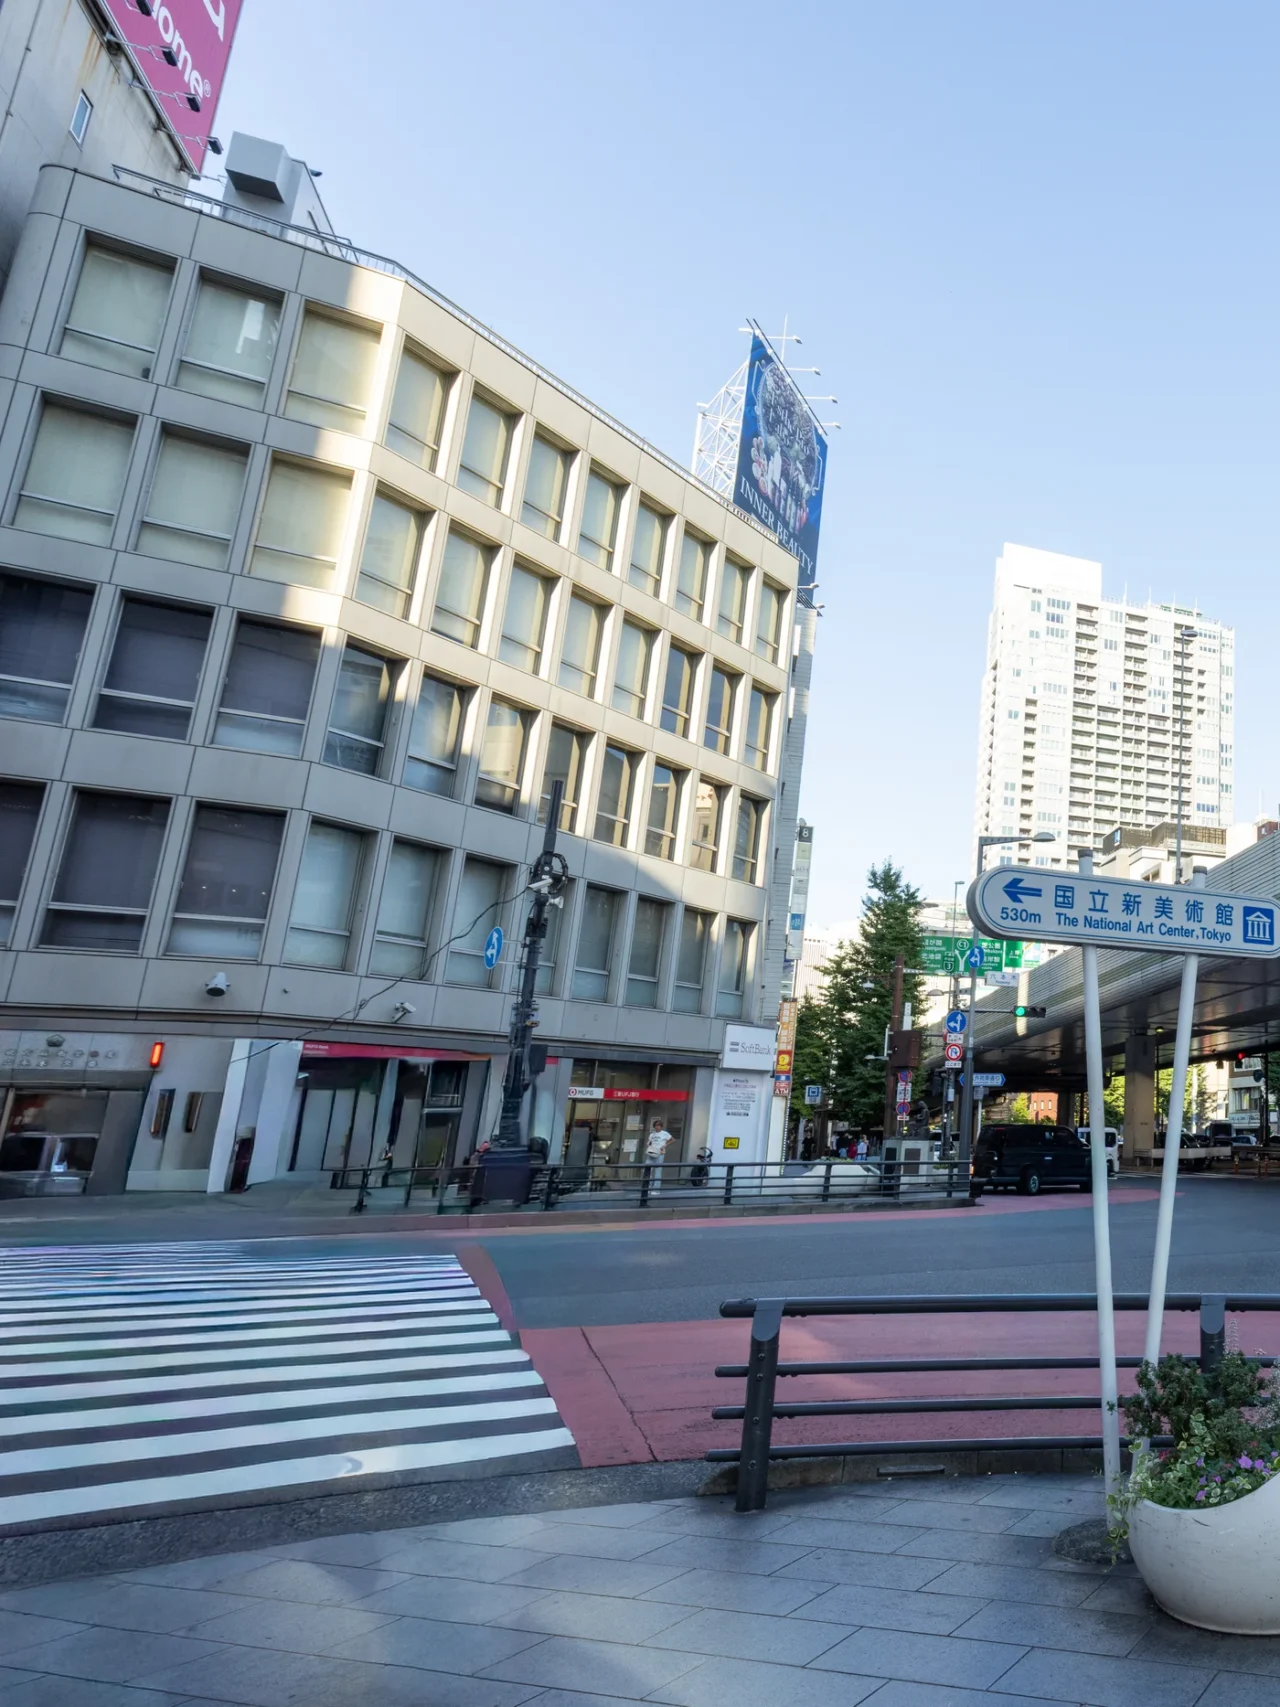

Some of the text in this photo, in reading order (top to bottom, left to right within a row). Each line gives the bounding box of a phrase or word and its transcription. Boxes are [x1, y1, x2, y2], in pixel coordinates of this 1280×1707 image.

[151, 0, 203, 101] ome
[740, 475, 813, 575] INNER BEAUTY
[1000, 906, 1041, 924] 530m
[1055, 912, 1078, 927] The
[1083, 915, 1132, 932] National
[1136, 920, 1154, 935] Art
[1054, 884, 1234, 926] 国立新美術館
[740, 1042, 771, 1055] SoftBank
